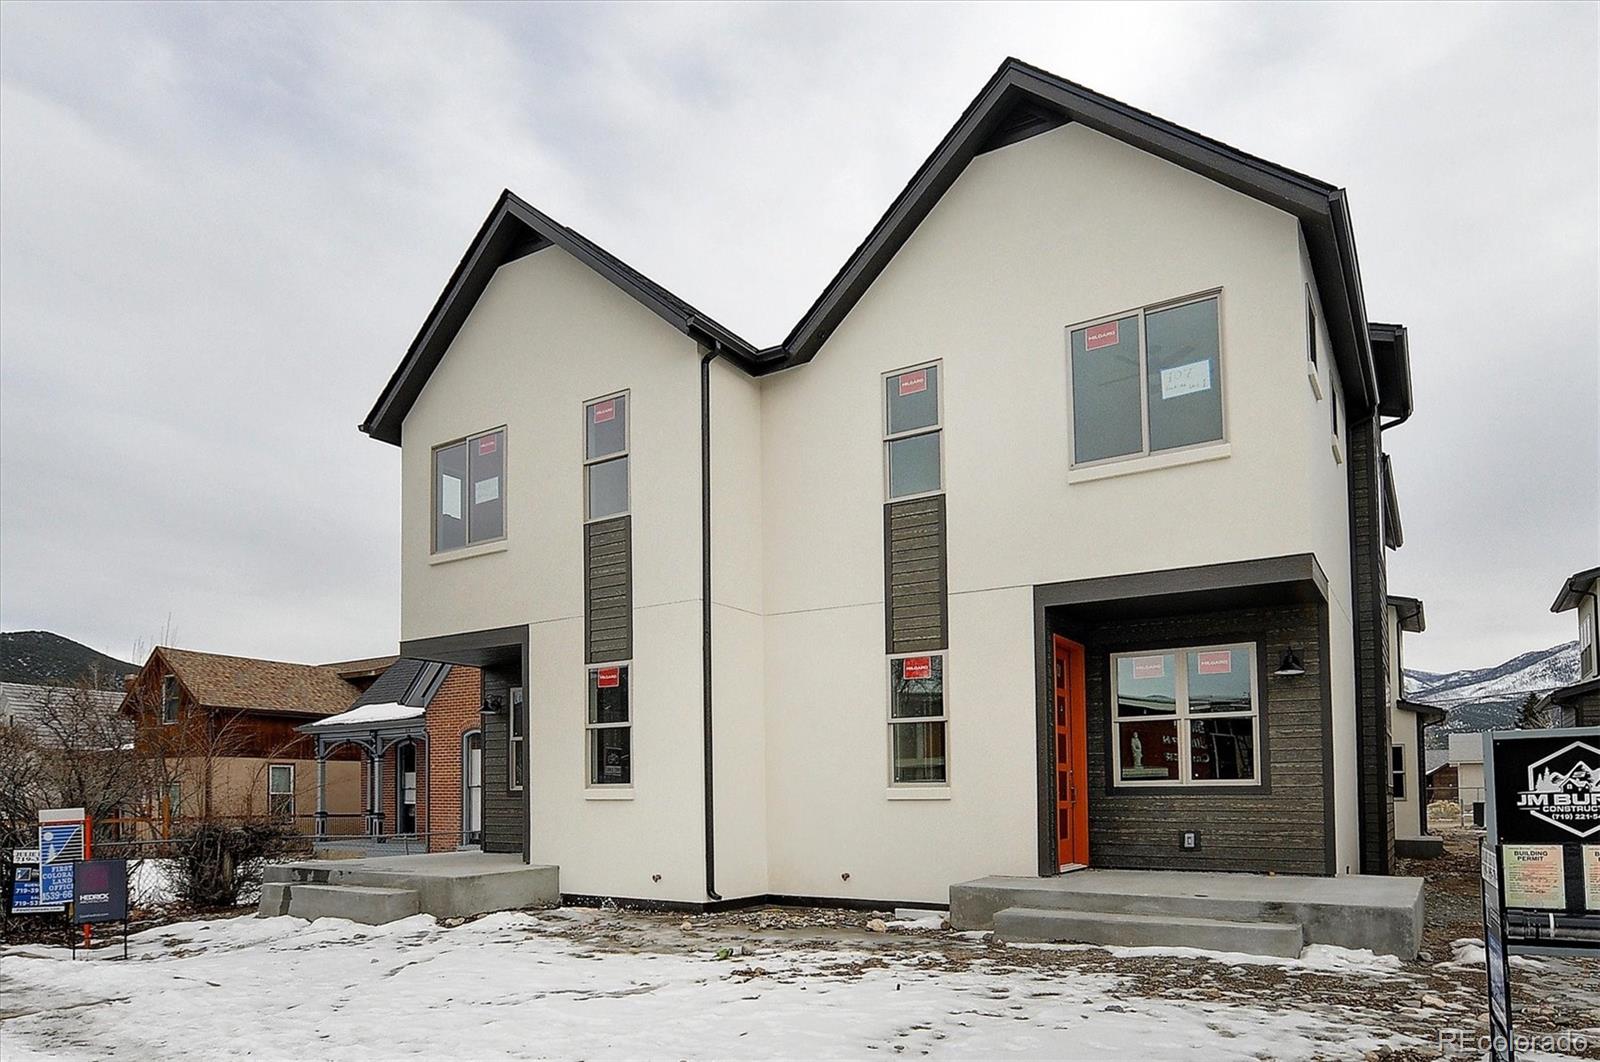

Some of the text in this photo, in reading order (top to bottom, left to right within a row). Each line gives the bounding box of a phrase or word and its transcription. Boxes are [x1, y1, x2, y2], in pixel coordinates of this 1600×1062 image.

[1517, 794, 1549, 807] JM
[1551, 813, 1574, 821] (719)
[51, 865, 73, 873] FIRST
